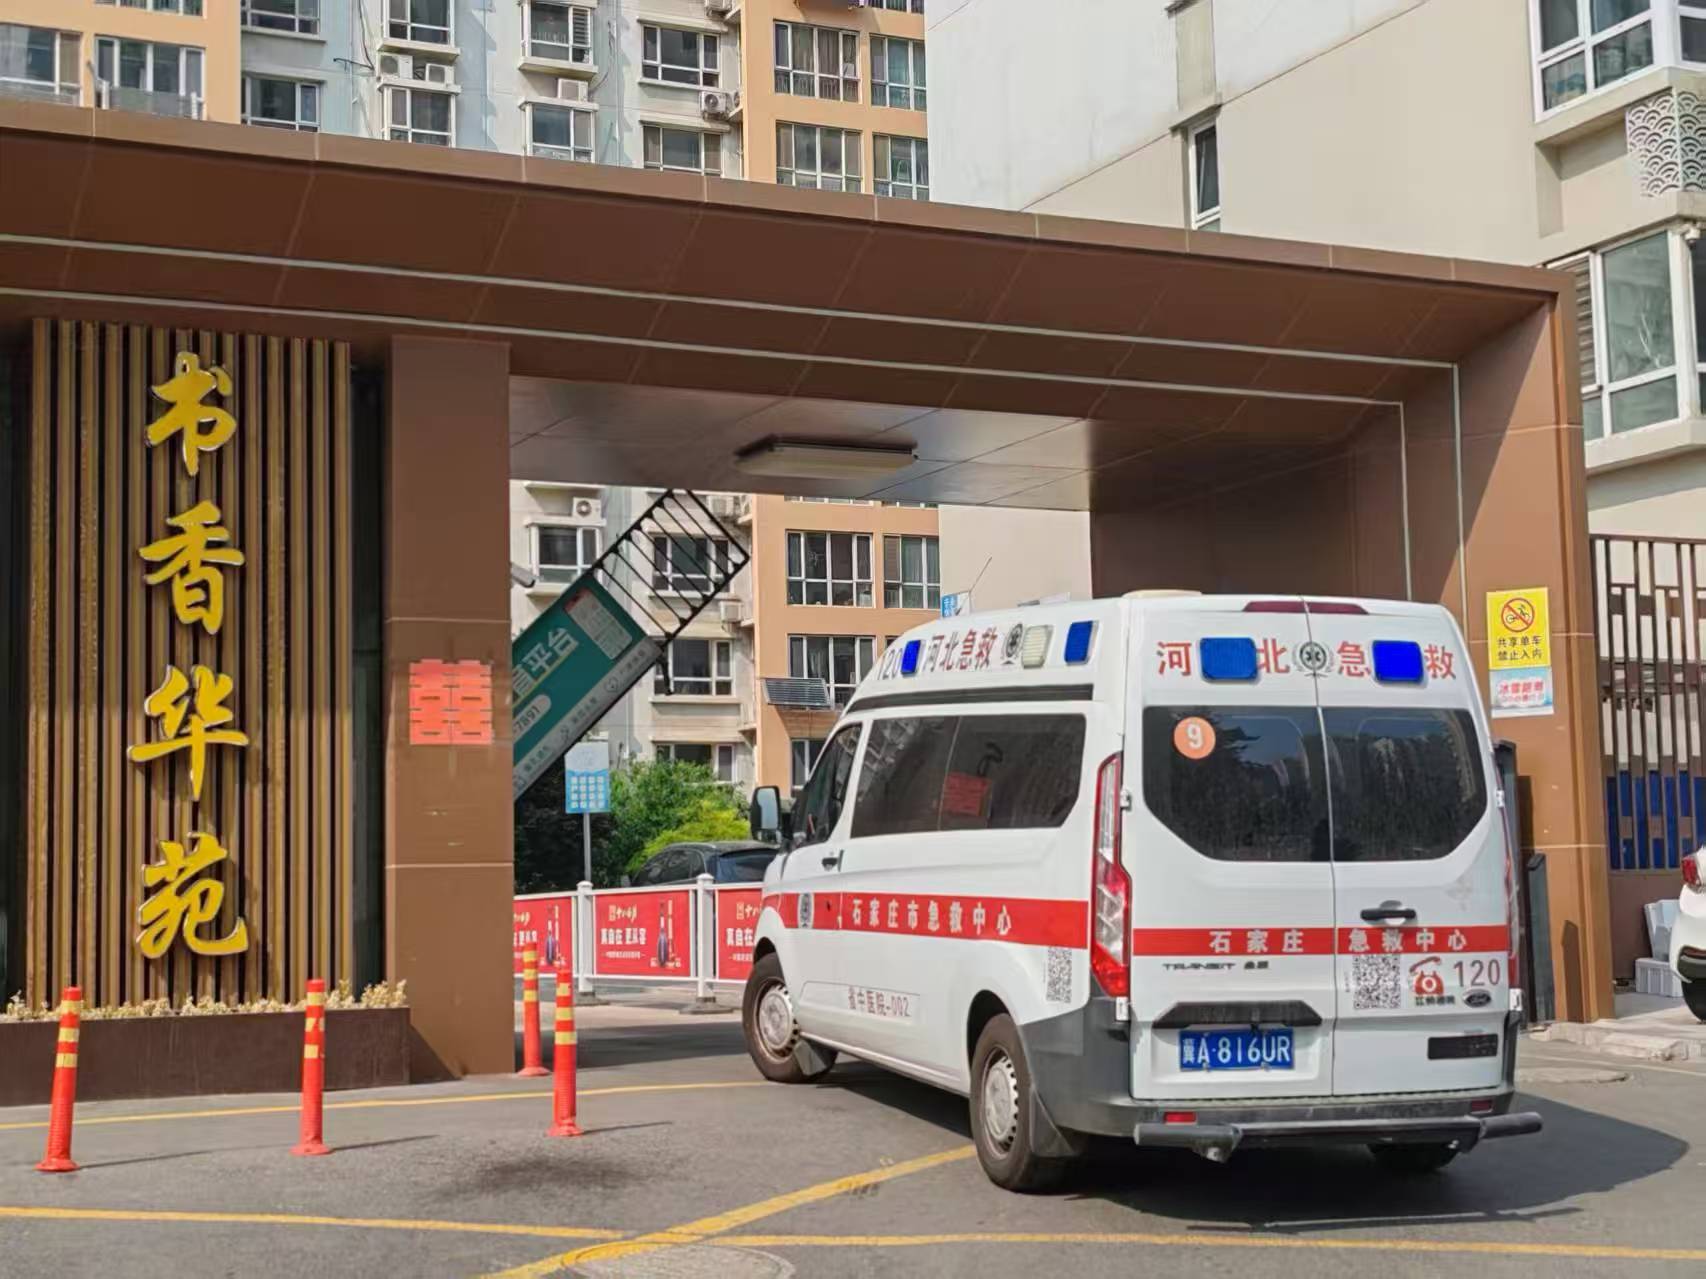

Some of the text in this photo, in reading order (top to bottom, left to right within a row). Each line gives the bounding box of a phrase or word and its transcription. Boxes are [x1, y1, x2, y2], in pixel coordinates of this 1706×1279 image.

[127, 350, 250, 959] 书香华苑
[922, 628, 998, 673] 河北急救
[1156, 638, 1457, 679] 河北急救
[1186, 725, 1203, 749] 9
[852, 898, 1012, 936] 石家庄市急救中心
[1209, 928, 1468, 953] 石家庄 急救中心
[1453, 959, 1501, 987] 120
